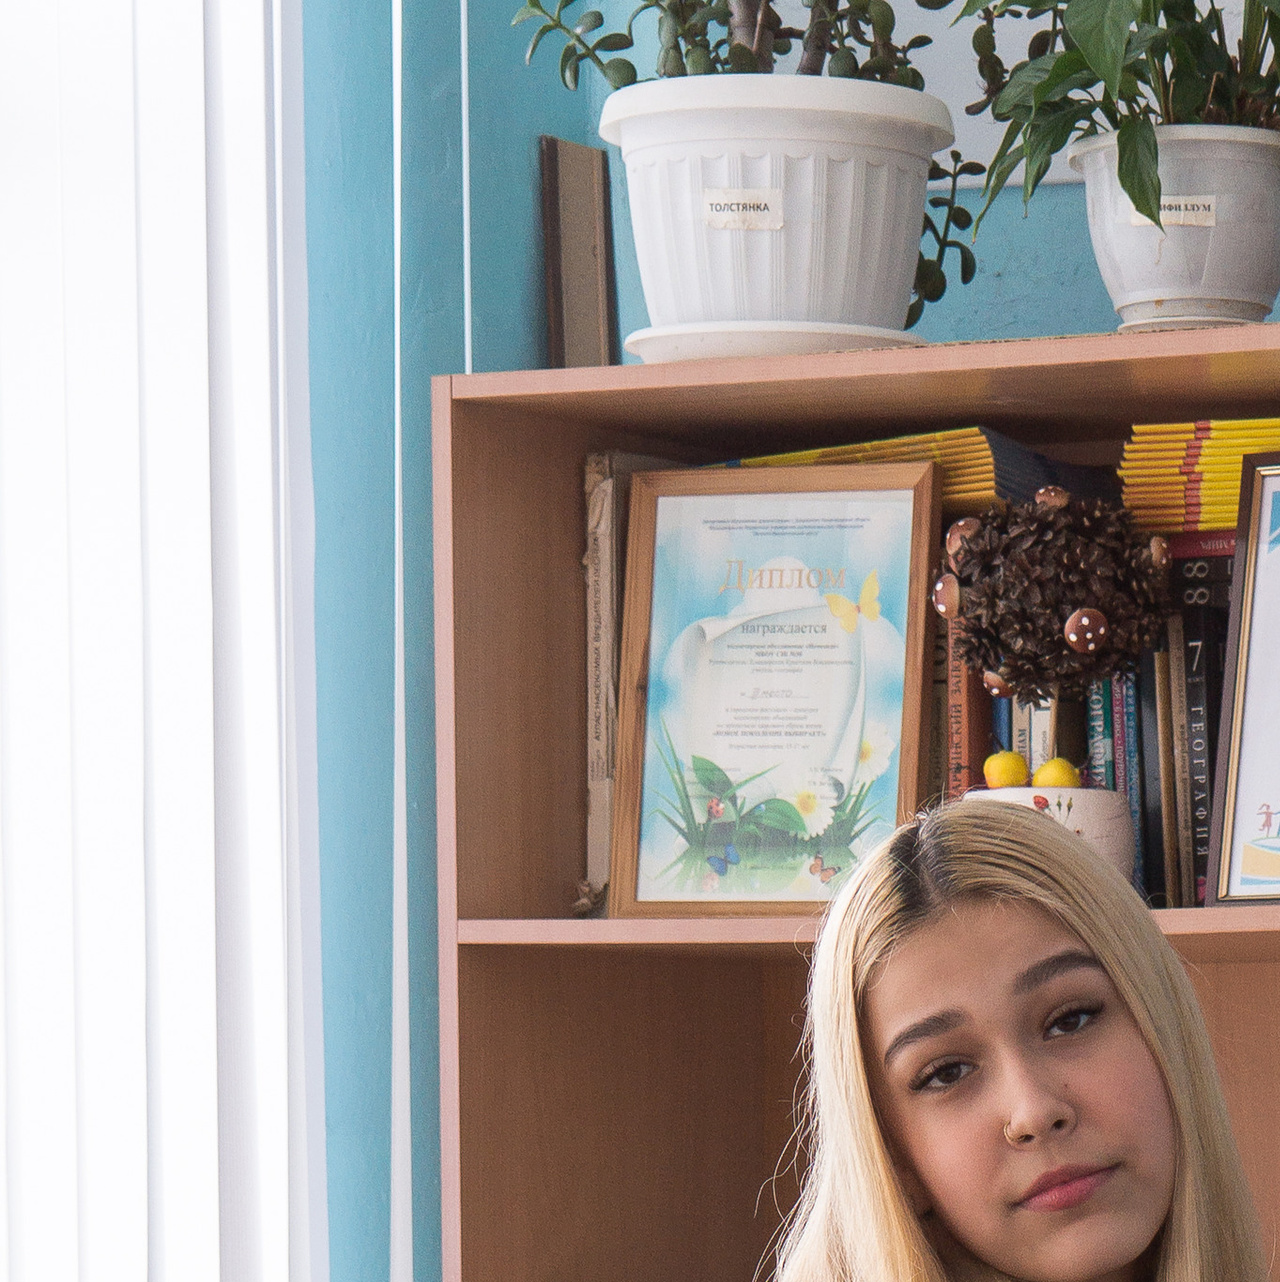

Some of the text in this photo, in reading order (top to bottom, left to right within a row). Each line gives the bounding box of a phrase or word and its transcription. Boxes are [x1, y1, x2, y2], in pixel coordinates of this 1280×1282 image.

[709, 202, 770, 213] ТОЛСТЯНКА
[1159, 203, 1212, 213] ИФИЛЛУМ
[719, 559, 847, 594] Диплом
[1183, 561, 1209, 578] 8
[1184, 587, 1210, 605] 8
[741, 624, 827, 636] награждается
[1084, 680, 1110, 790] ЕОГРАФИЯ
[1186, 705, 1214, 857] ГЕОГРАФИЯ
